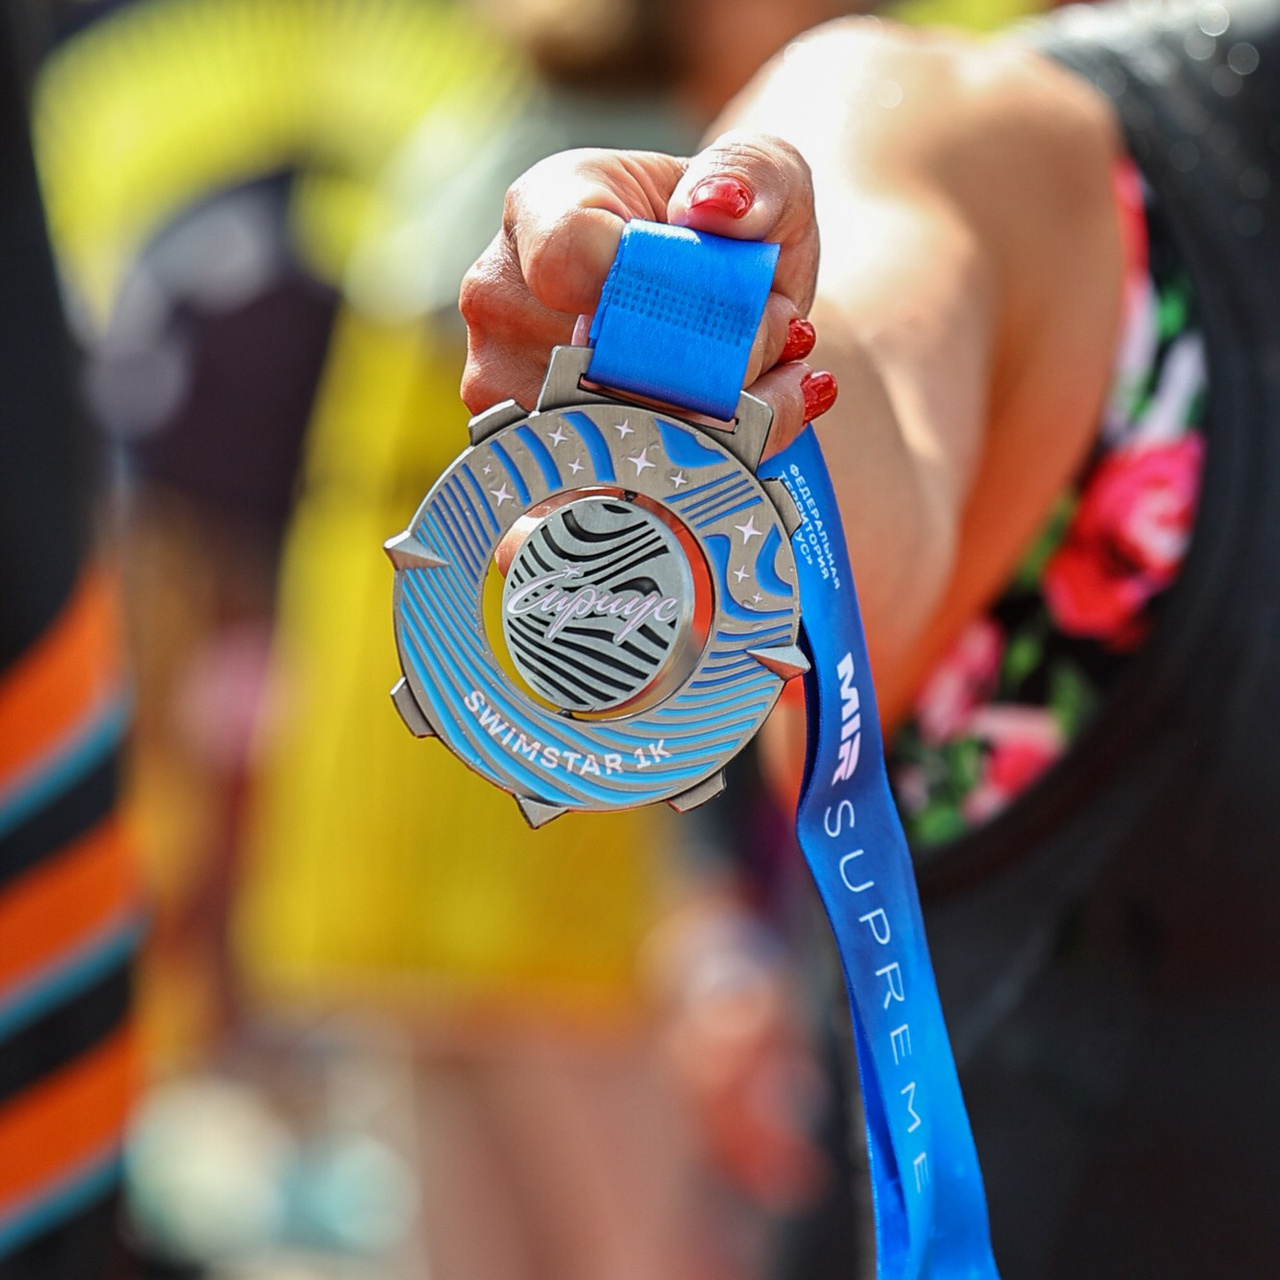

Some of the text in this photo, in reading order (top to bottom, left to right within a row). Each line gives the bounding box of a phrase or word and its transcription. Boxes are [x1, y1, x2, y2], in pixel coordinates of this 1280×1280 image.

[789, 463, 841, 590] ФЕДЕРАЛЬНАЯ
[507, 565, 678, 642] Сириус
[463, 689, 672, 776] SWIMSTAR 1K
[824, 651, 931, 1195] MIR SUPREME
